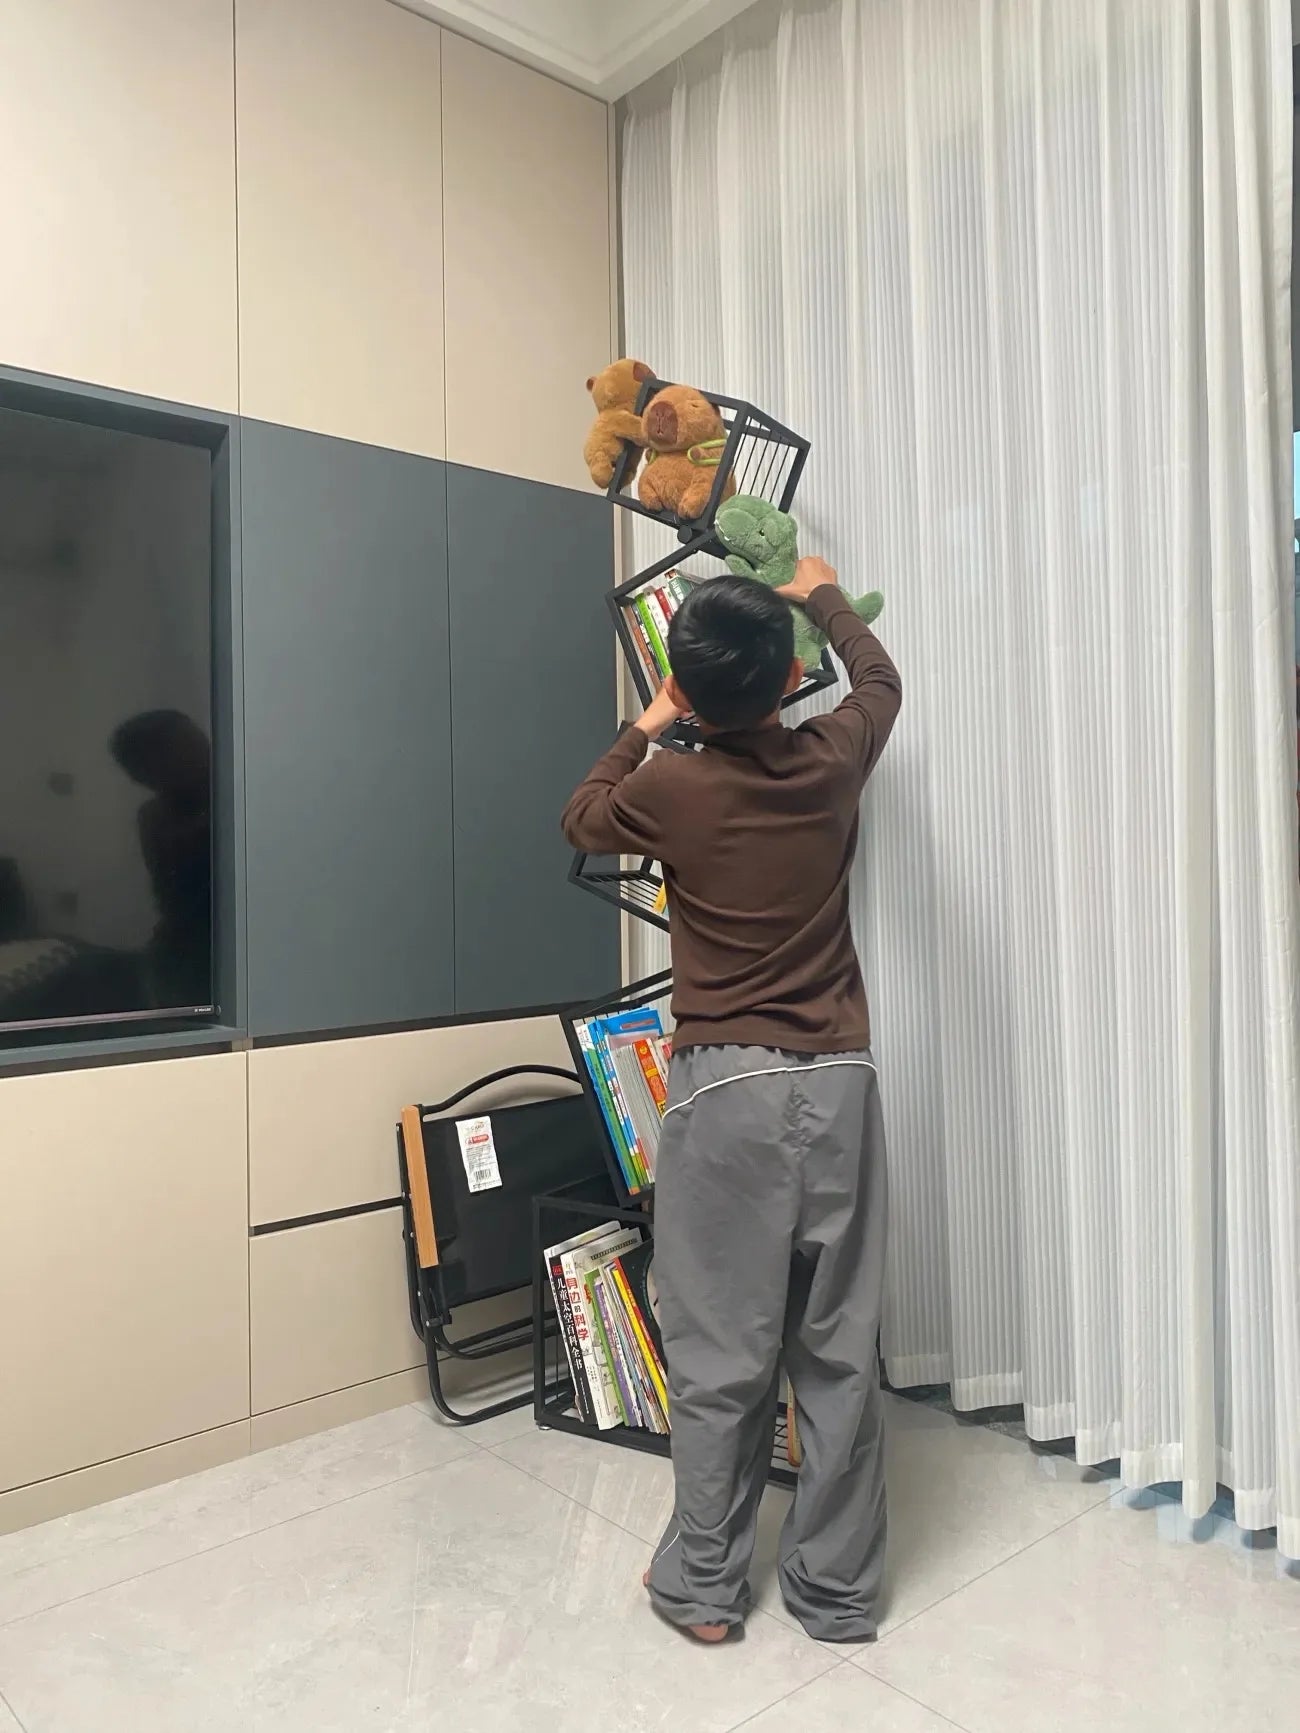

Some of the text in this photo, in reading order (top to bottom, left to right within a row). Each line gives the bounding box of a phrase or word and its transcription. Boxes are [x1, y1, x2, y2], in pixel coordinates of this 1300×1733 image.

[557, 1277, 583, 1370] 儿童太空百科全书
